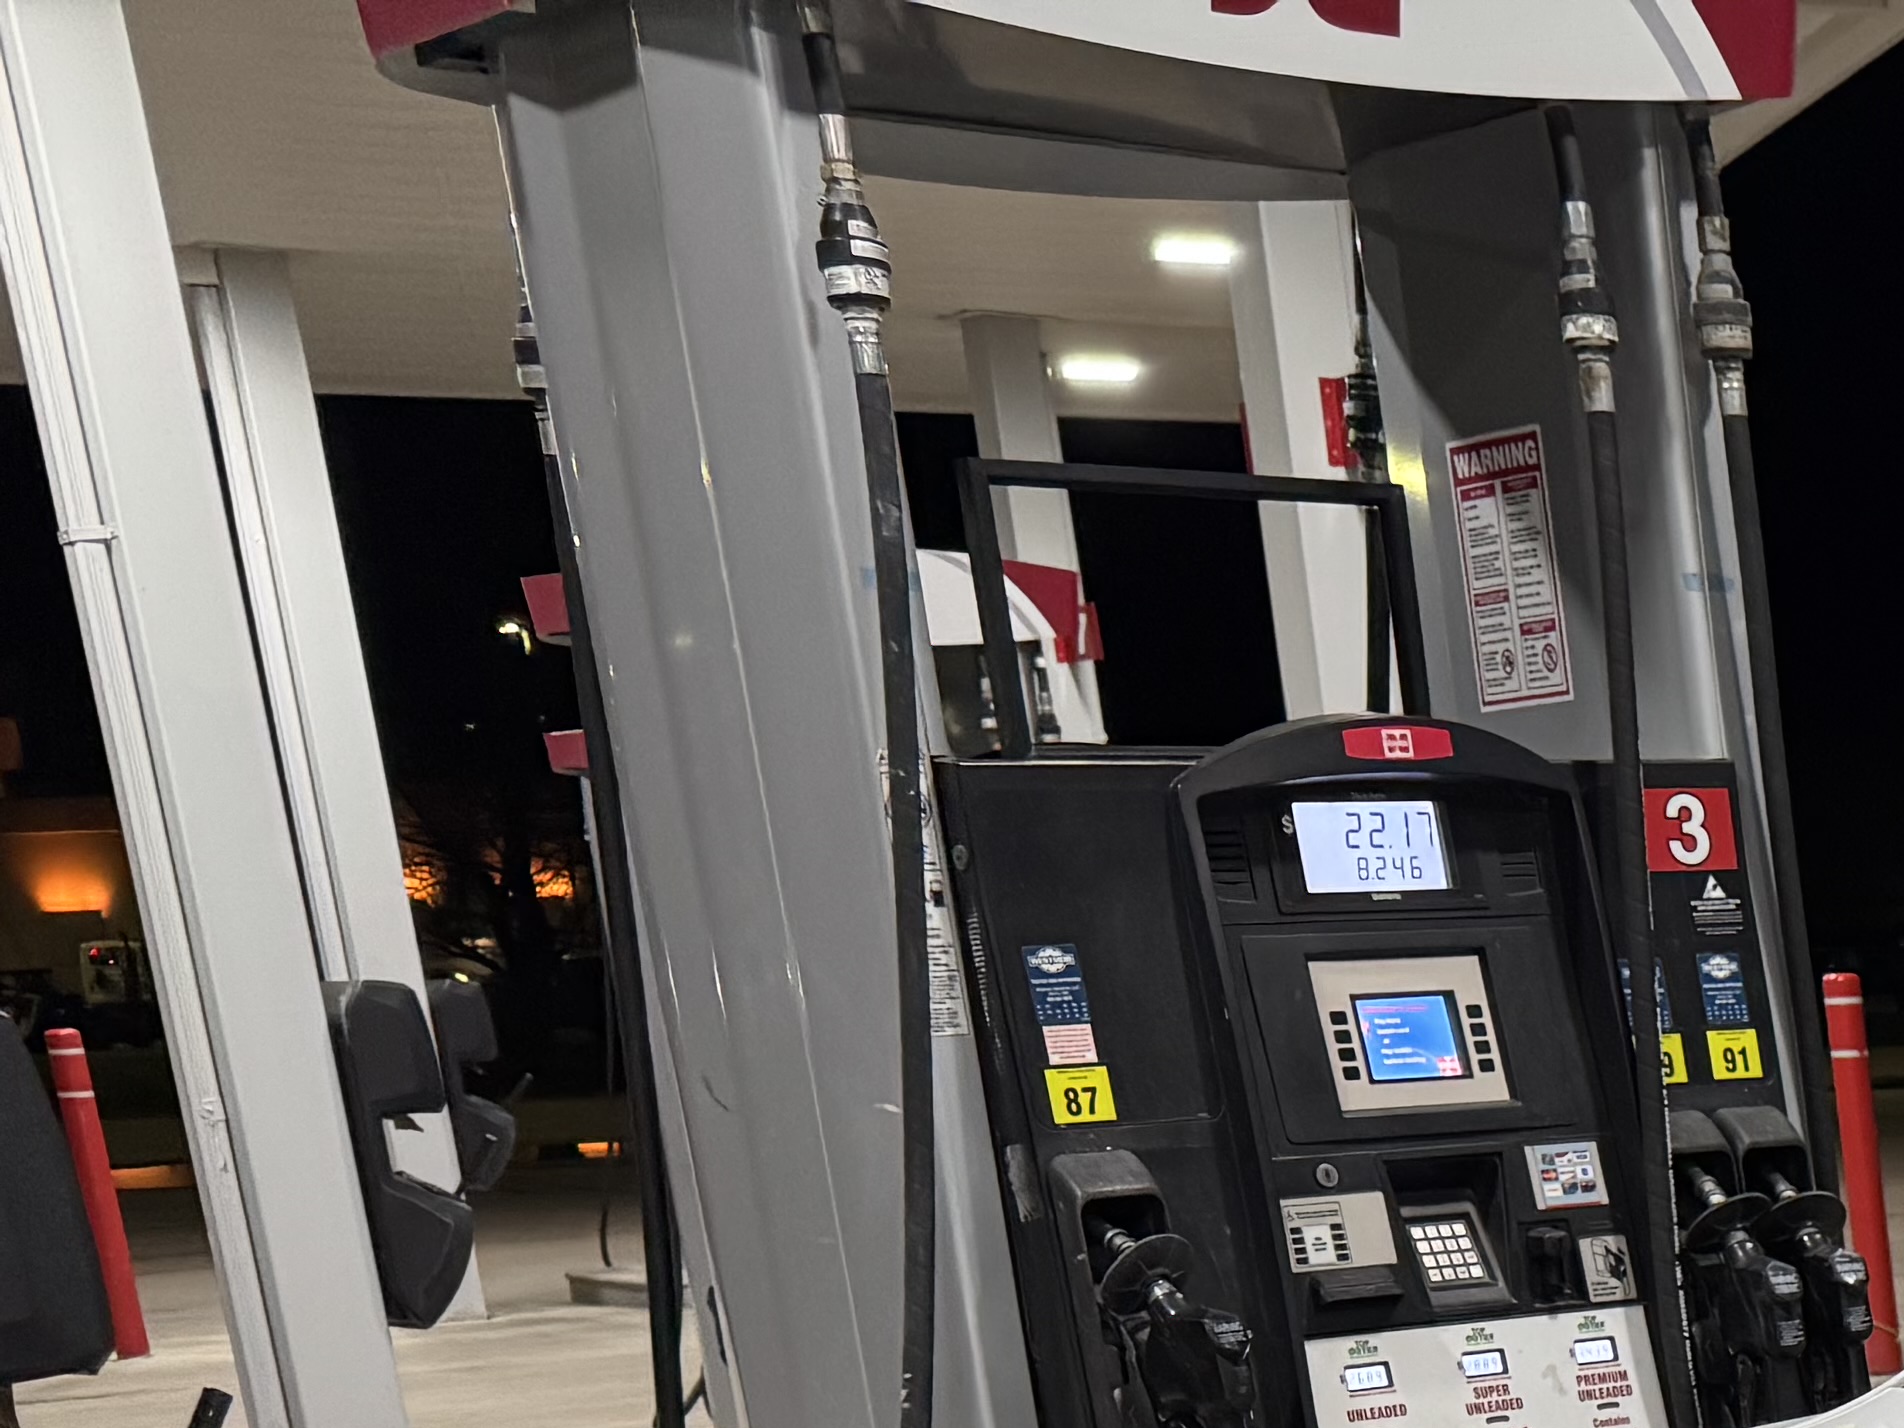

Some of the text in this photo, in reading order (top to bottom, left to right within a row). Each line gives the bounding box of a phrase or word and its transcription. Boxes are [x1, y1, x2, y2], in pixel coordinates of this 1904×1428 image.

[1453, 439, 1538, 479] WARNING
[1345, 812, 1433, 849] 22.17
[1665, 793, 1711, 866] 3
[1357, 856, 1422, 881] 8.246
[1723, 1046, 1750, 1073] 91
[1064, 1086, 1098, 1117] 87
[1576, 1370, 1628, 1387] PREMIUM
[1473, 1384, 1510, 1400] SUPER
[1577, 1384, 1632, 1402] UNLEADED
[1347, 1403, 1407, 1422] UNLEADED
[1465, 1397, 1523, 1416] UNLEADED
[1593, 1416, 1630, 1428] Contains
